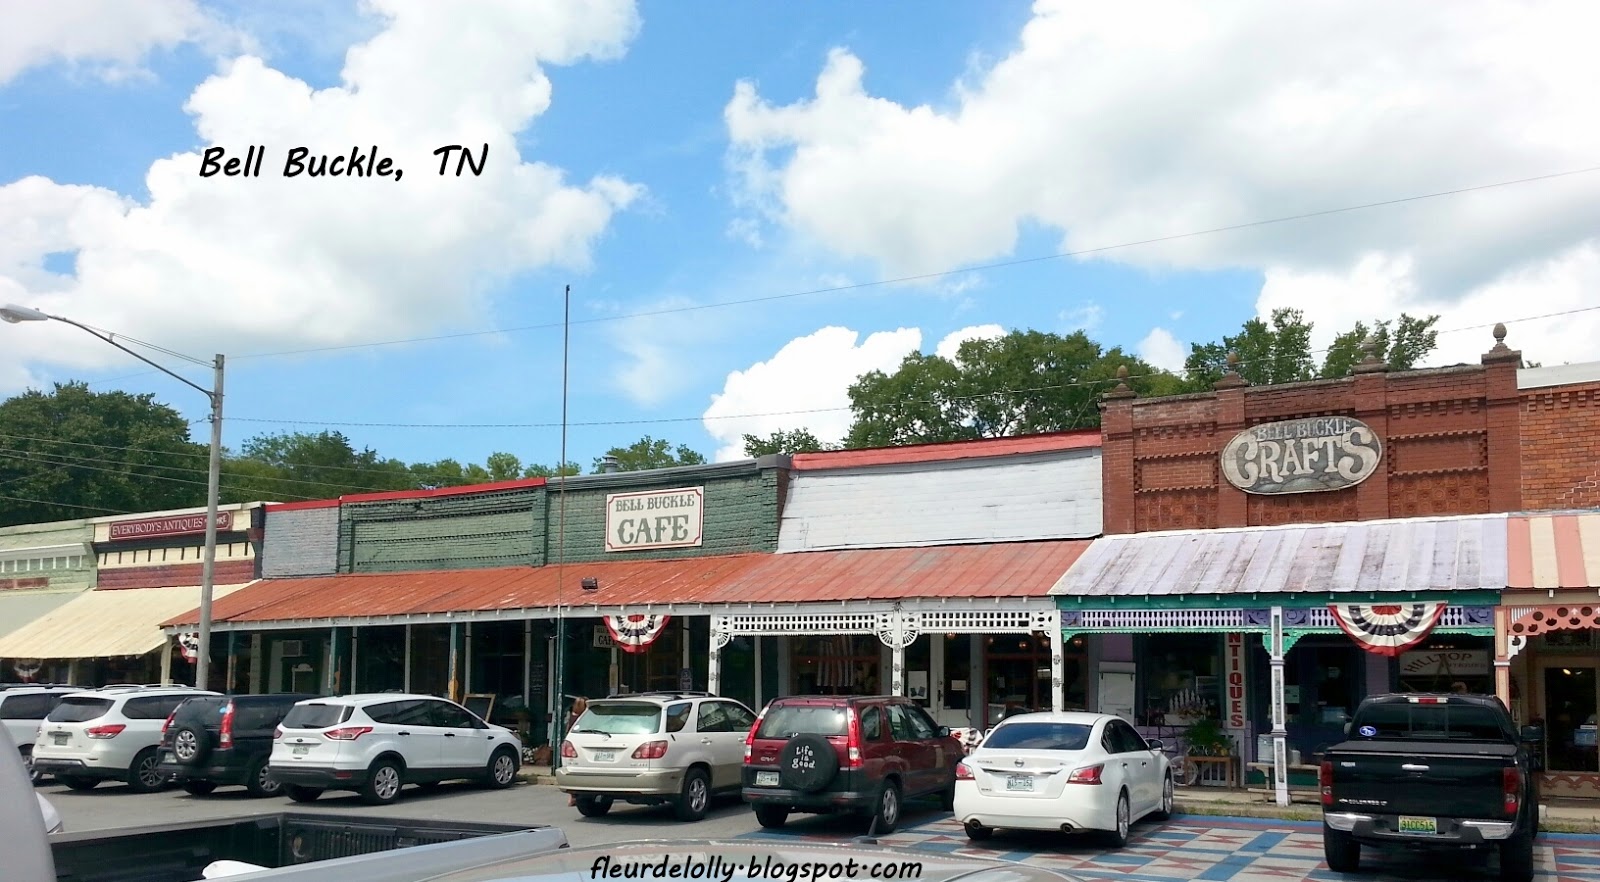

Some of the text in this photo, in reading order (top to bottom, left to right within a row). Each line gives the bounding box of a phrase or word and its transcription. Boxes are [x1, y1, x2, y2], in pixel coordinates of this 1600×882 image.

[1255, 418, 1351, 442] BELL BUCKLE
[1222, 426, 1378, 488] CRAFTS
[615, 494, 695, 512] BELL BUCKLE
[112, 521, 162, 536] EVERYBODY'S
[163, 517, 203, 531] ANTIQUES
[617, 514, 689, 545] CAFE
[1403, 652, 1473, 673] HILLTOP
[1228, 632, 1244, 728] NTIQUES
[795, 745, 814, 757] Life
